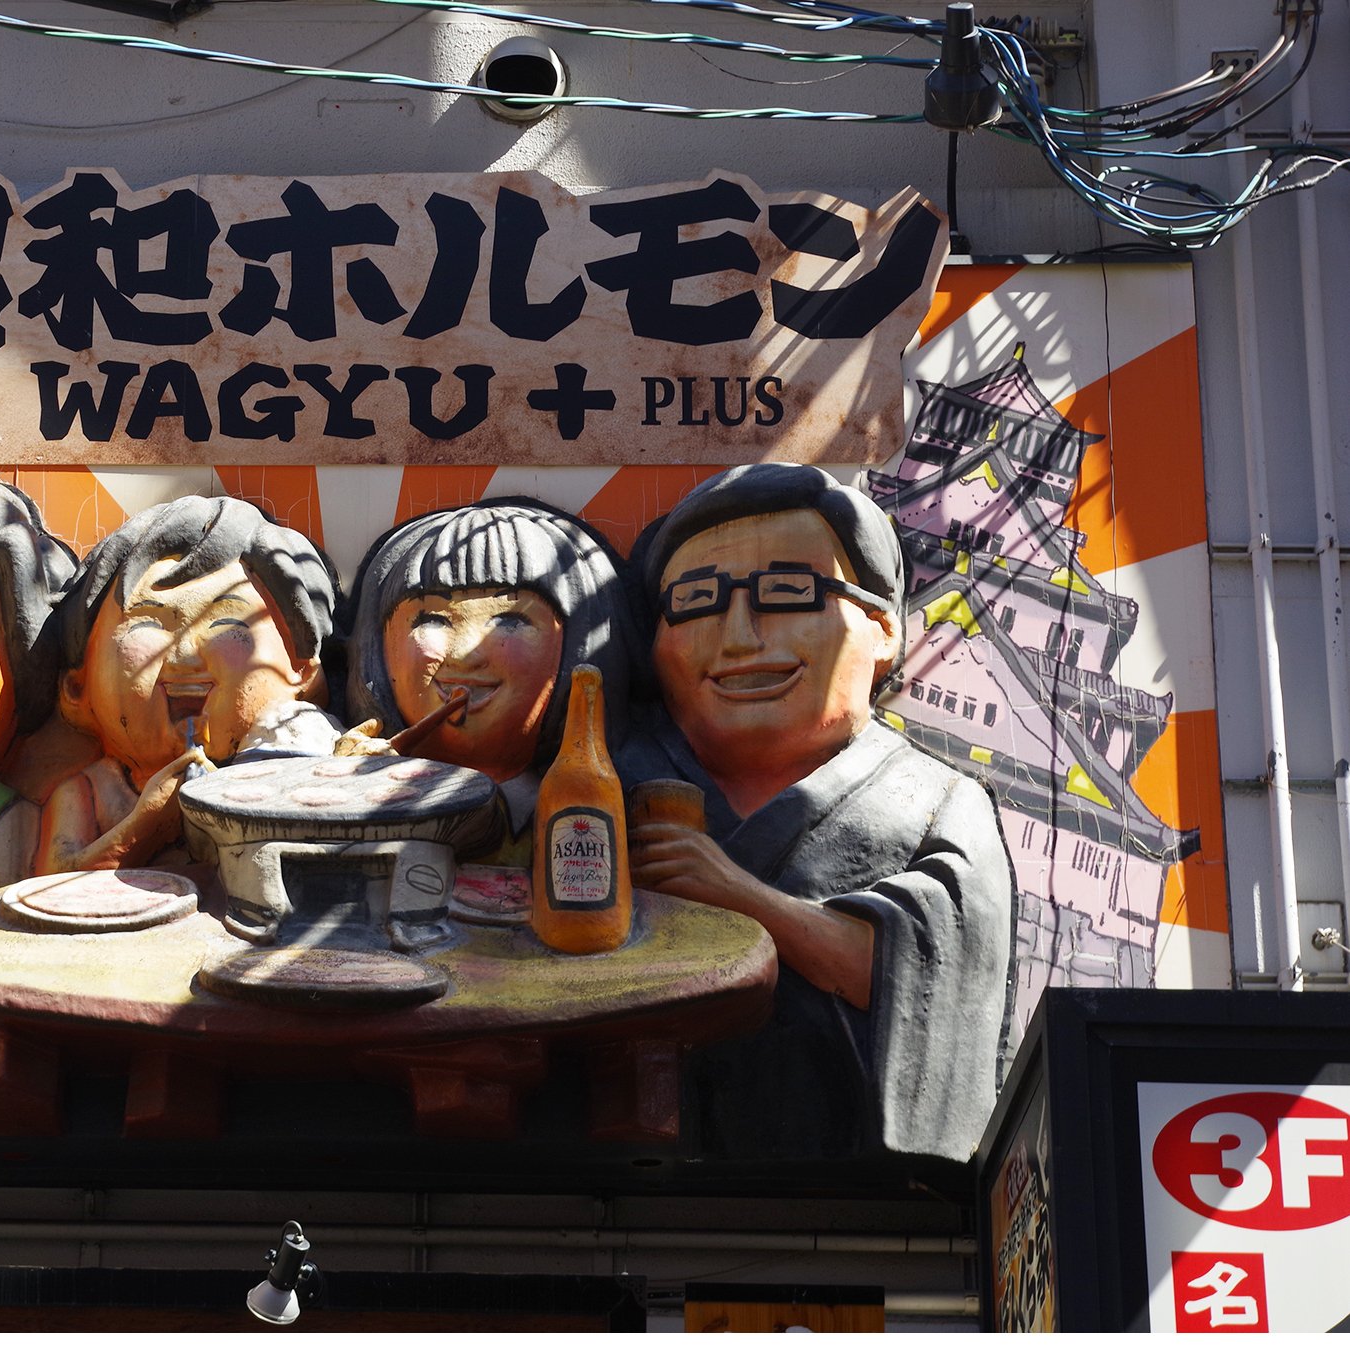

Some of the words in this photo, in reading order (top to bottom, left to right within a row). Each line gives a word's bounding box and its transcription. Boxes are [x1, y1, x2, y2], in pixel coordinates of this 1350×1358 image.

[30, 361, 496, 442] WAGYU
[641, 377, 783, 426] PLUS
[553, 841, 605, 860] ASAHI
[1189, 1112, 1349, 1212] 3F
[1184, 1261, 1259, 1328] 名
